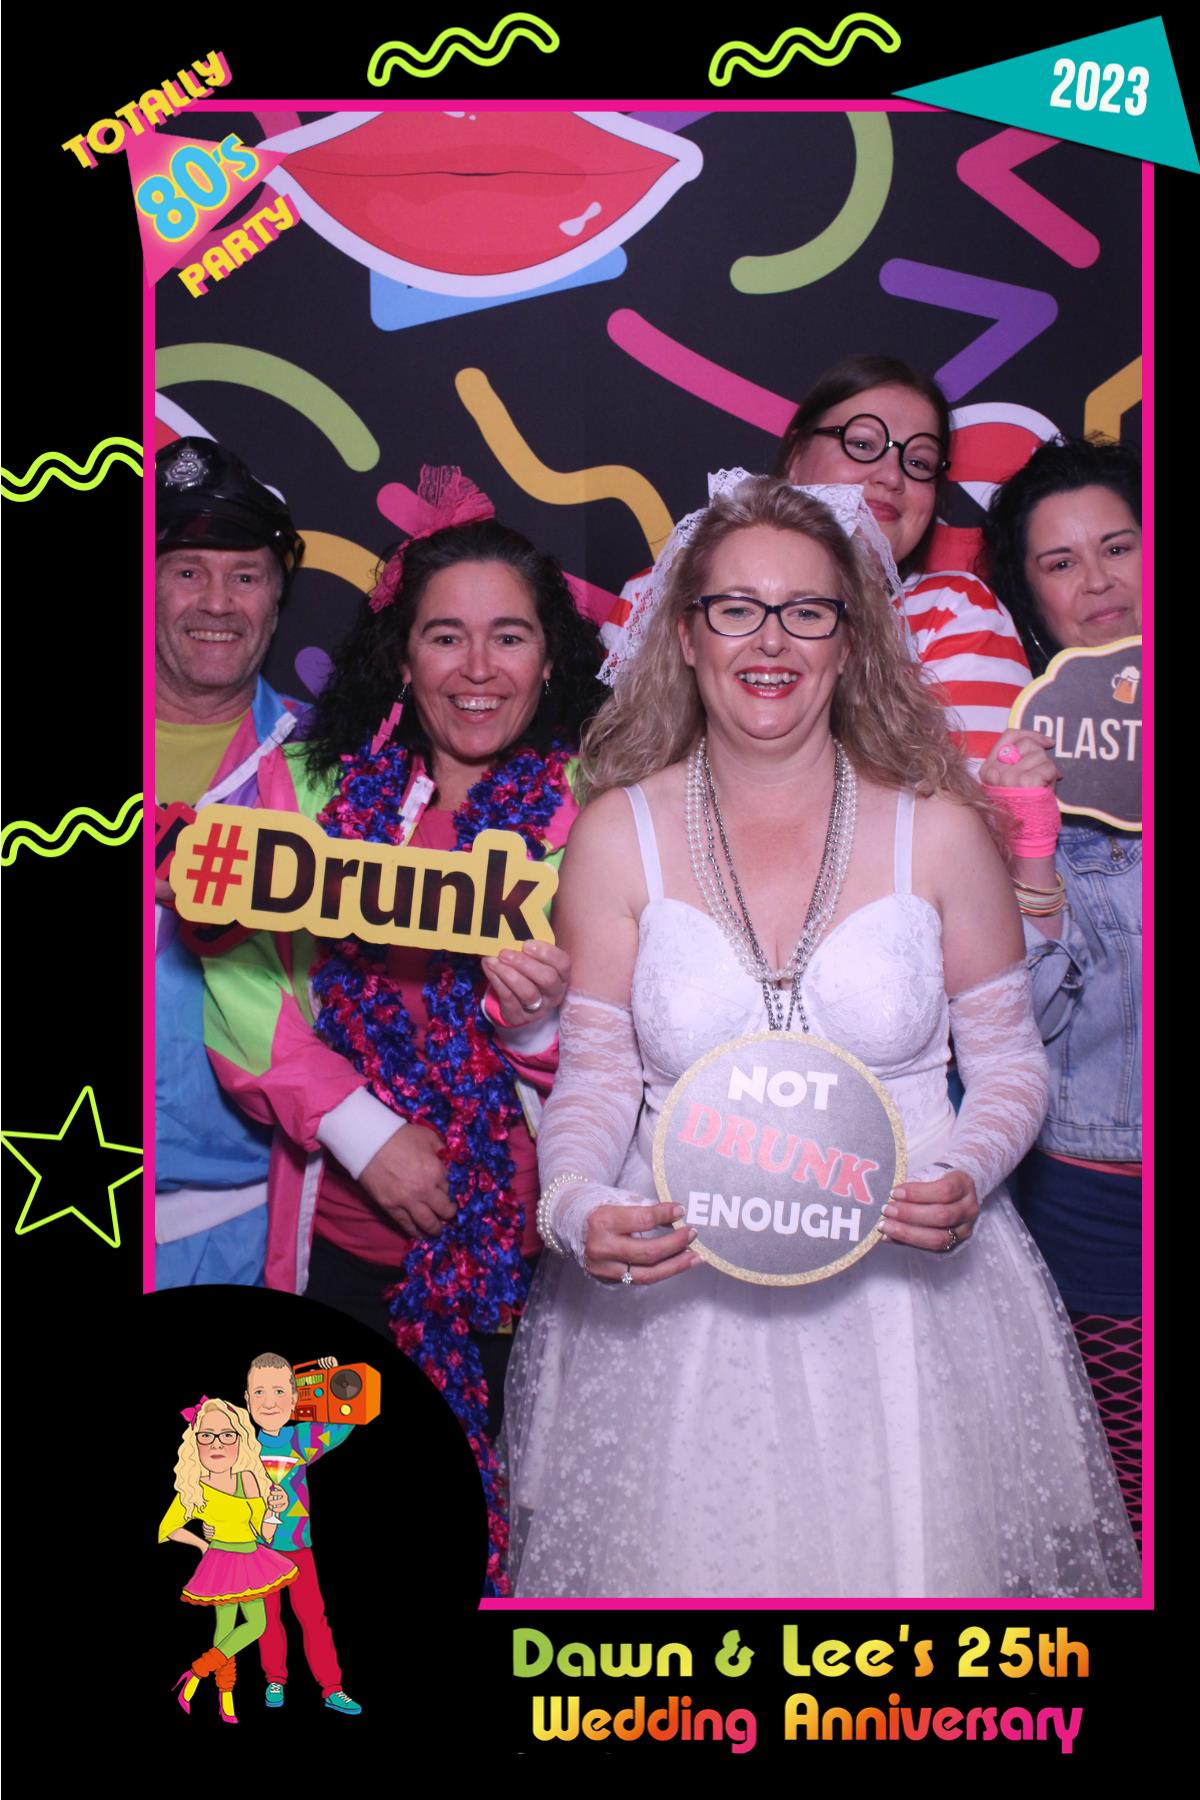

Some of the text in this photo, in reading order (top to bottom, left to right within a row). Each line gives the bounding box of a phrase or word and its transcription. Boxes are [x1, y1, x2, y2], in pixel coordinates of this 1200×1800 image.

[186, 822, 539, 942] #Drunk
[728, 1065, 838, 1110] NOT
[677, 1102, 880, 1205] DRUNK
[686, 1191, 861, 1241] ENOUGH
